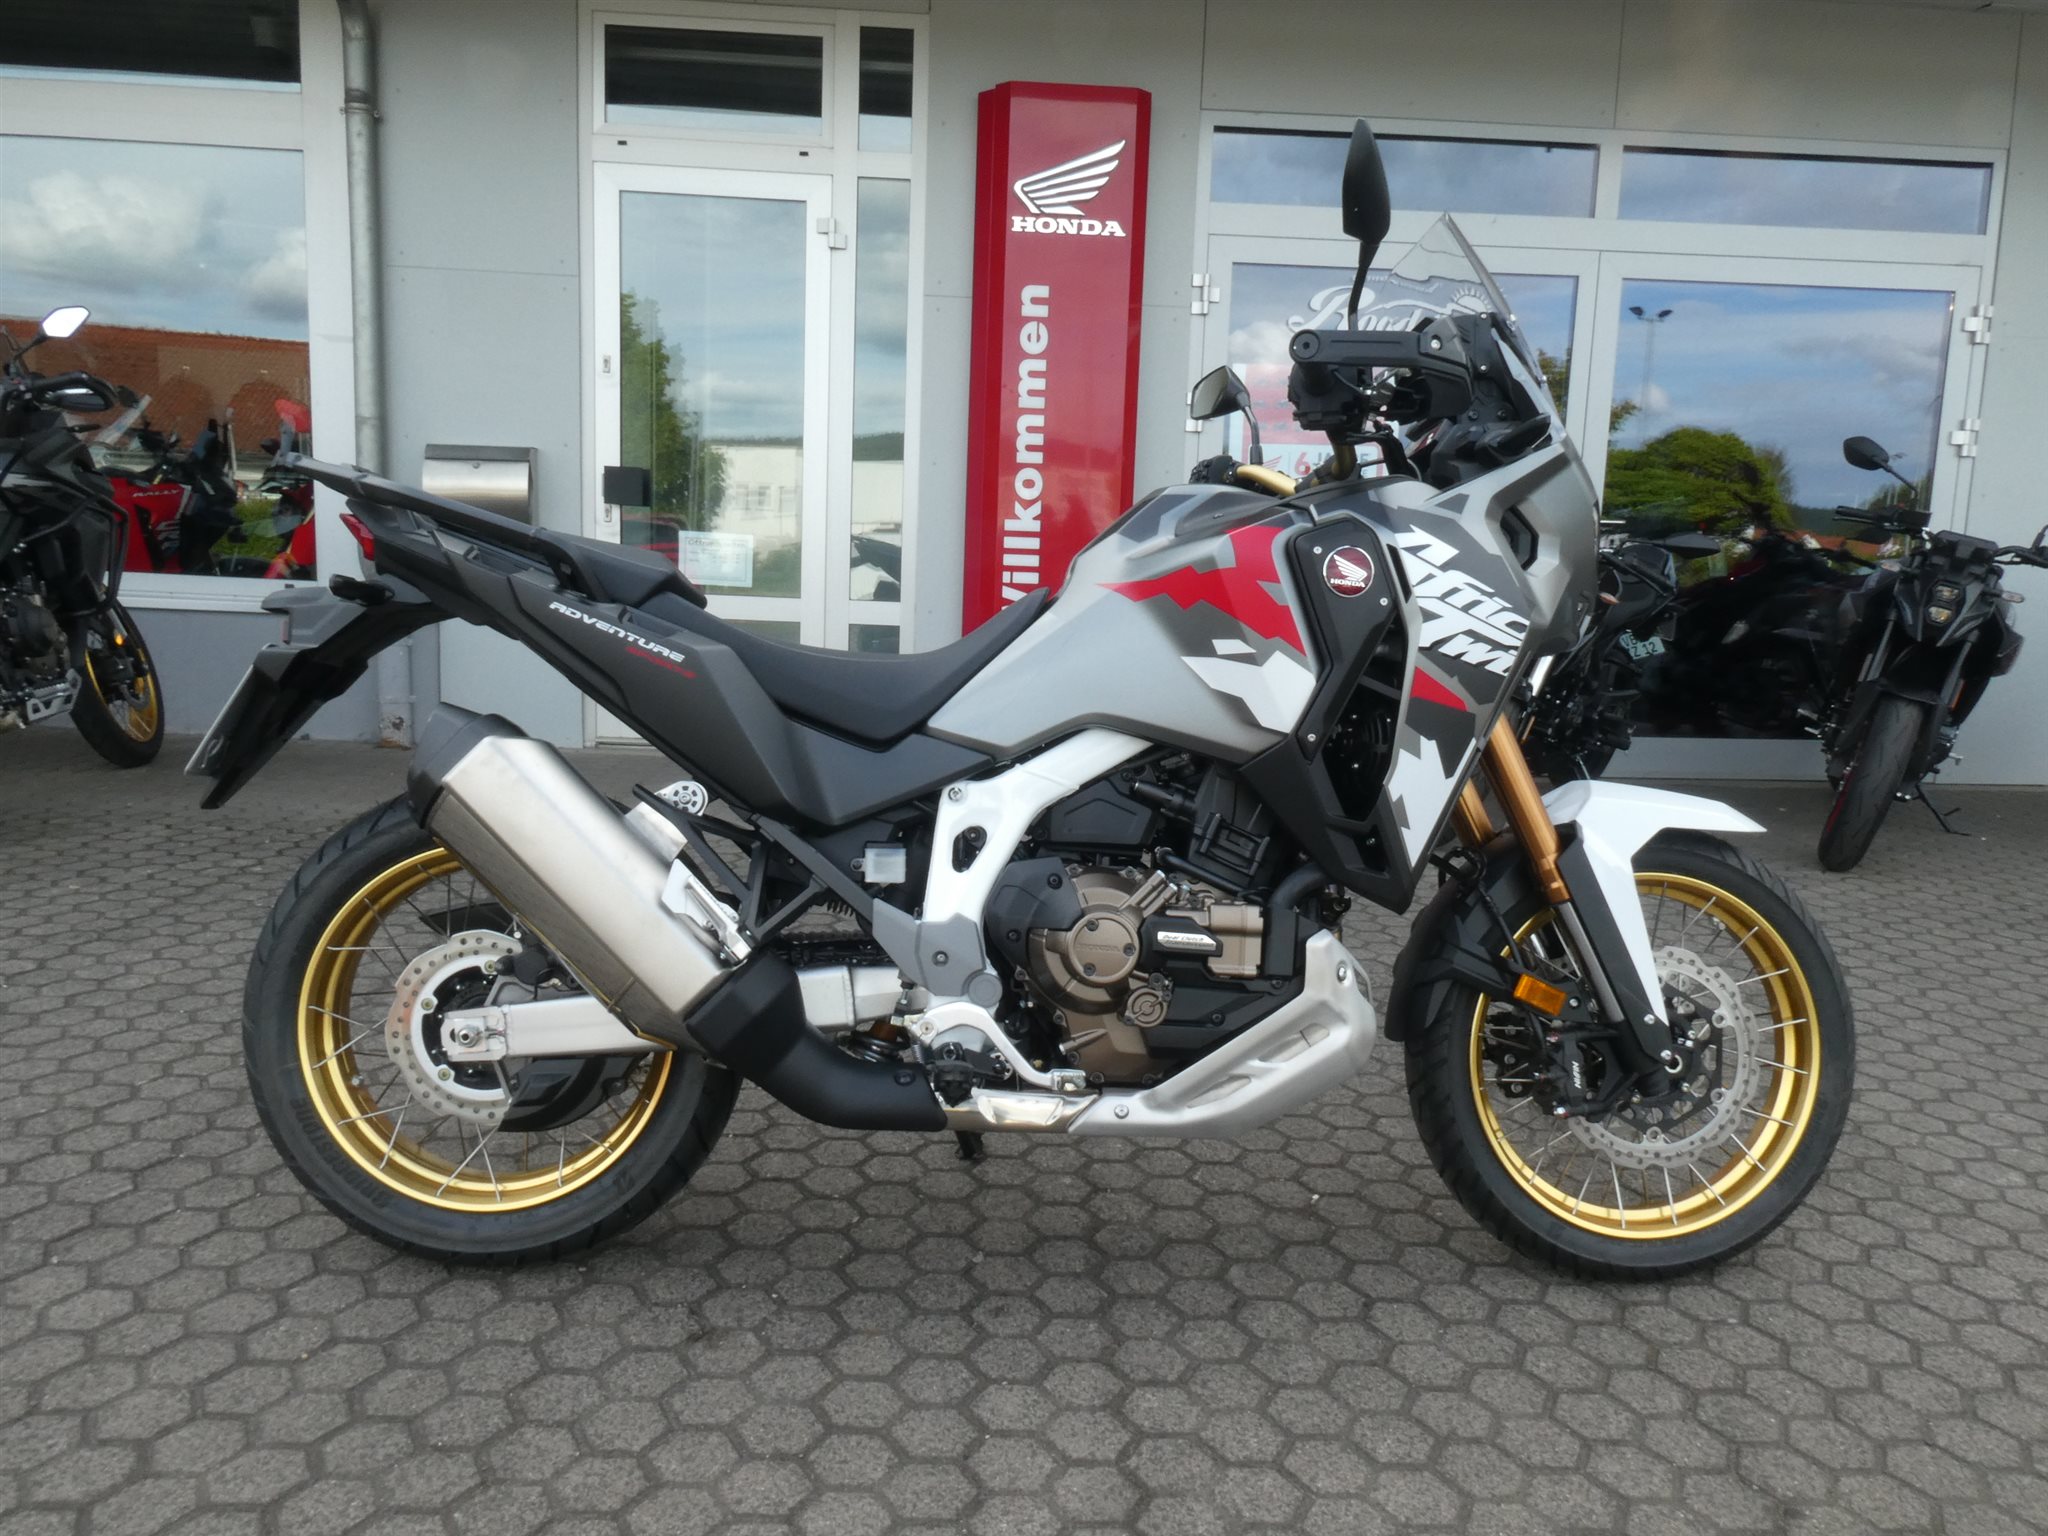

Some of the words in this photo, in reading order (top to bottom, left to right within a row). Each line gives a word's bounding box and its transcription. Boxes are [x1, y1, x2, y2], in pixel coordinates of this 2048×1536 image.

[1011, 216, 1126, 237] HONDA
[1002, 285, 1050, 611] illkommen
[1295, 452, 1311, 476] 6
[1330, 578, 1366, 588] HONDA
[549, 601, 685, 663] ADVENTURE
[1631, 646, 1641, 657] Z
[1641, 641, 1658, 654] 12
